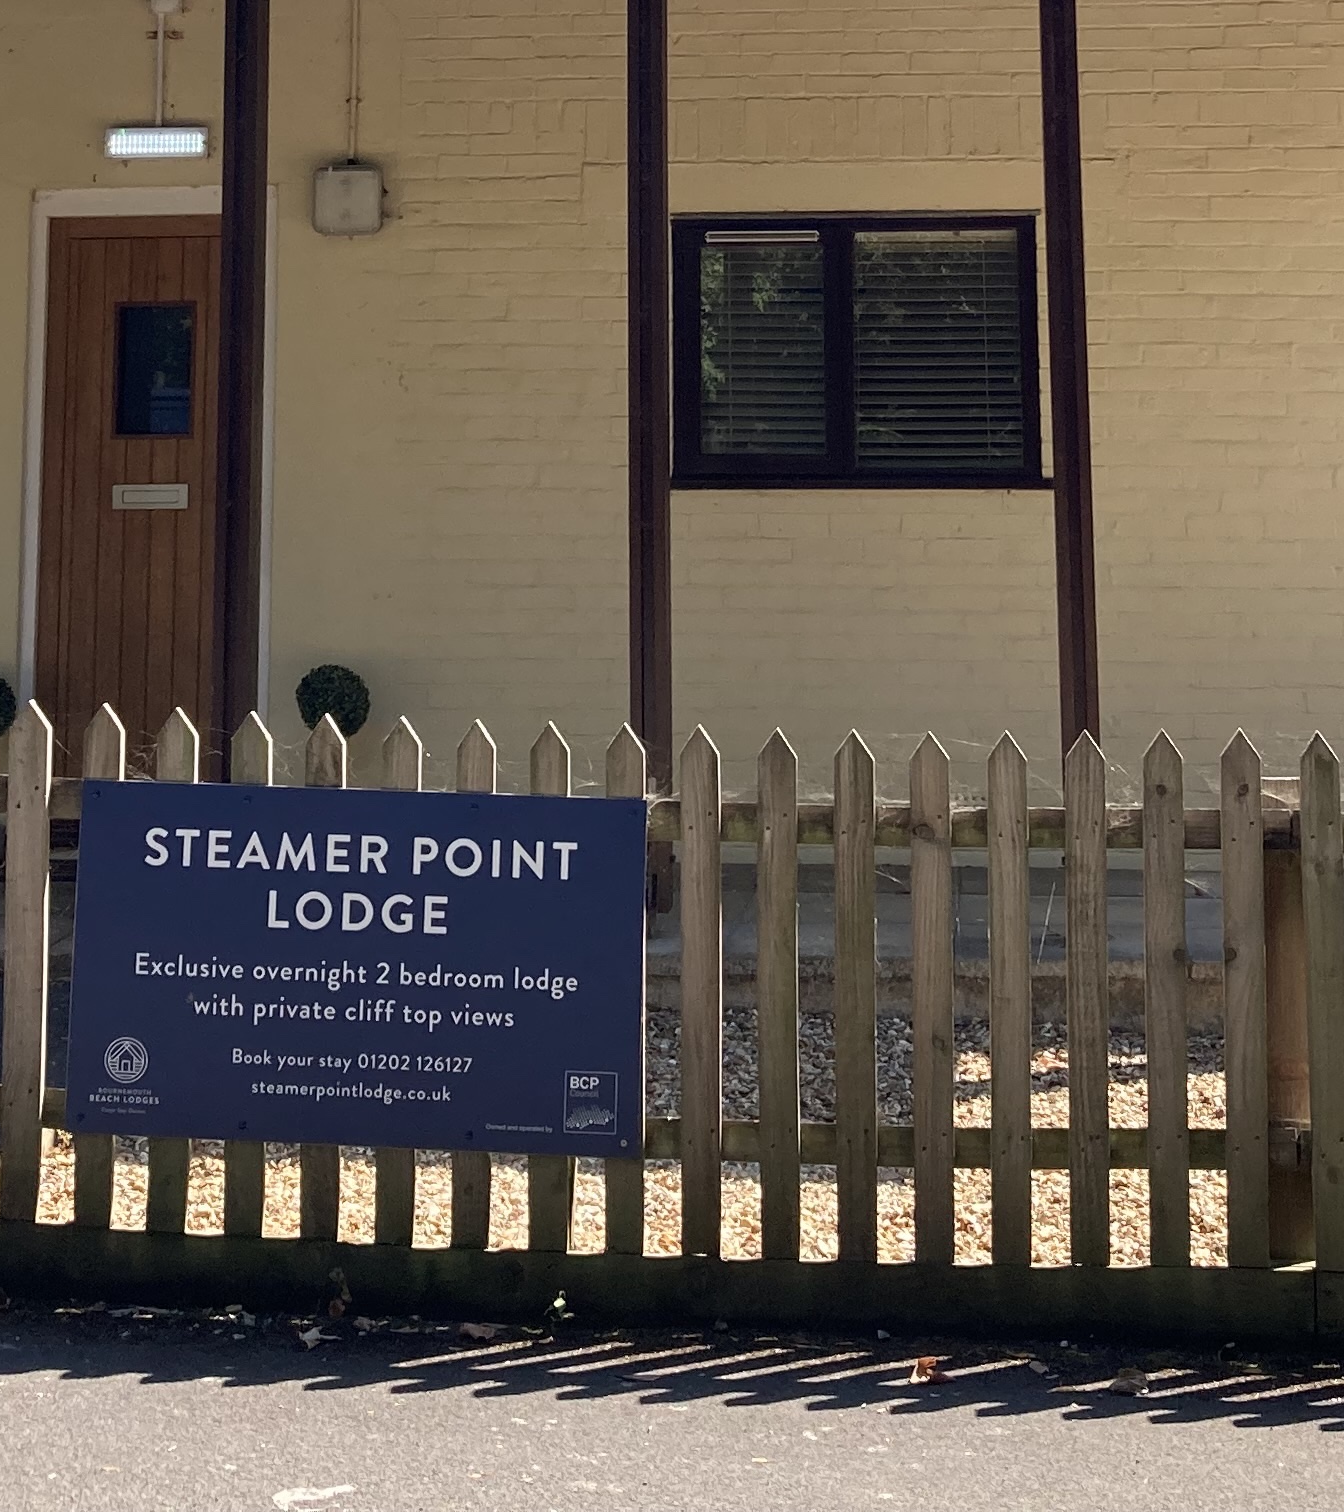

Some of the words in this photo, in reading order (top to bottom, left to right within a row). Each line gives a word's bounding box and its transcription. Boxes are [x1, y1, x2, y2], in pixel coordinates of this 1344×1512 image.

[144, 827, 389, 874] STEAMER
[412, 836, 578, 881] POINT
[267, 889, 449, 935] LODGE
[135, 952, 244, 979] Exclusive
[252, 960, 367, 991] overnight
[376, 962, 390, 985] 2
[399, 962, 504, 989] bedroom
[514, 967, 578, 999] lodge
[194, 994, 244, 1017] with
[253, 997, 337, 1026] private
[345, 999, 396, 1023] cliff
[403, 1004, 442, 1032] top
[451, 1003, 514, 1027] views
[232, 1047, 272, 1066] Book
[277, 1054, 314, 1071] your
[319, 1054, 352, 1073] stay
[358, 1053, 410, 1071] 01202
[416, 1055, 473, 1073] 126127
[251, 1080, 451, 1104] steamerpointlodge.co.uk
[569, 1076, 600, 1090] BCP
[89, 1094, 120, 1103] BEACH
[123, 1096, 160, 1105] LODGES
